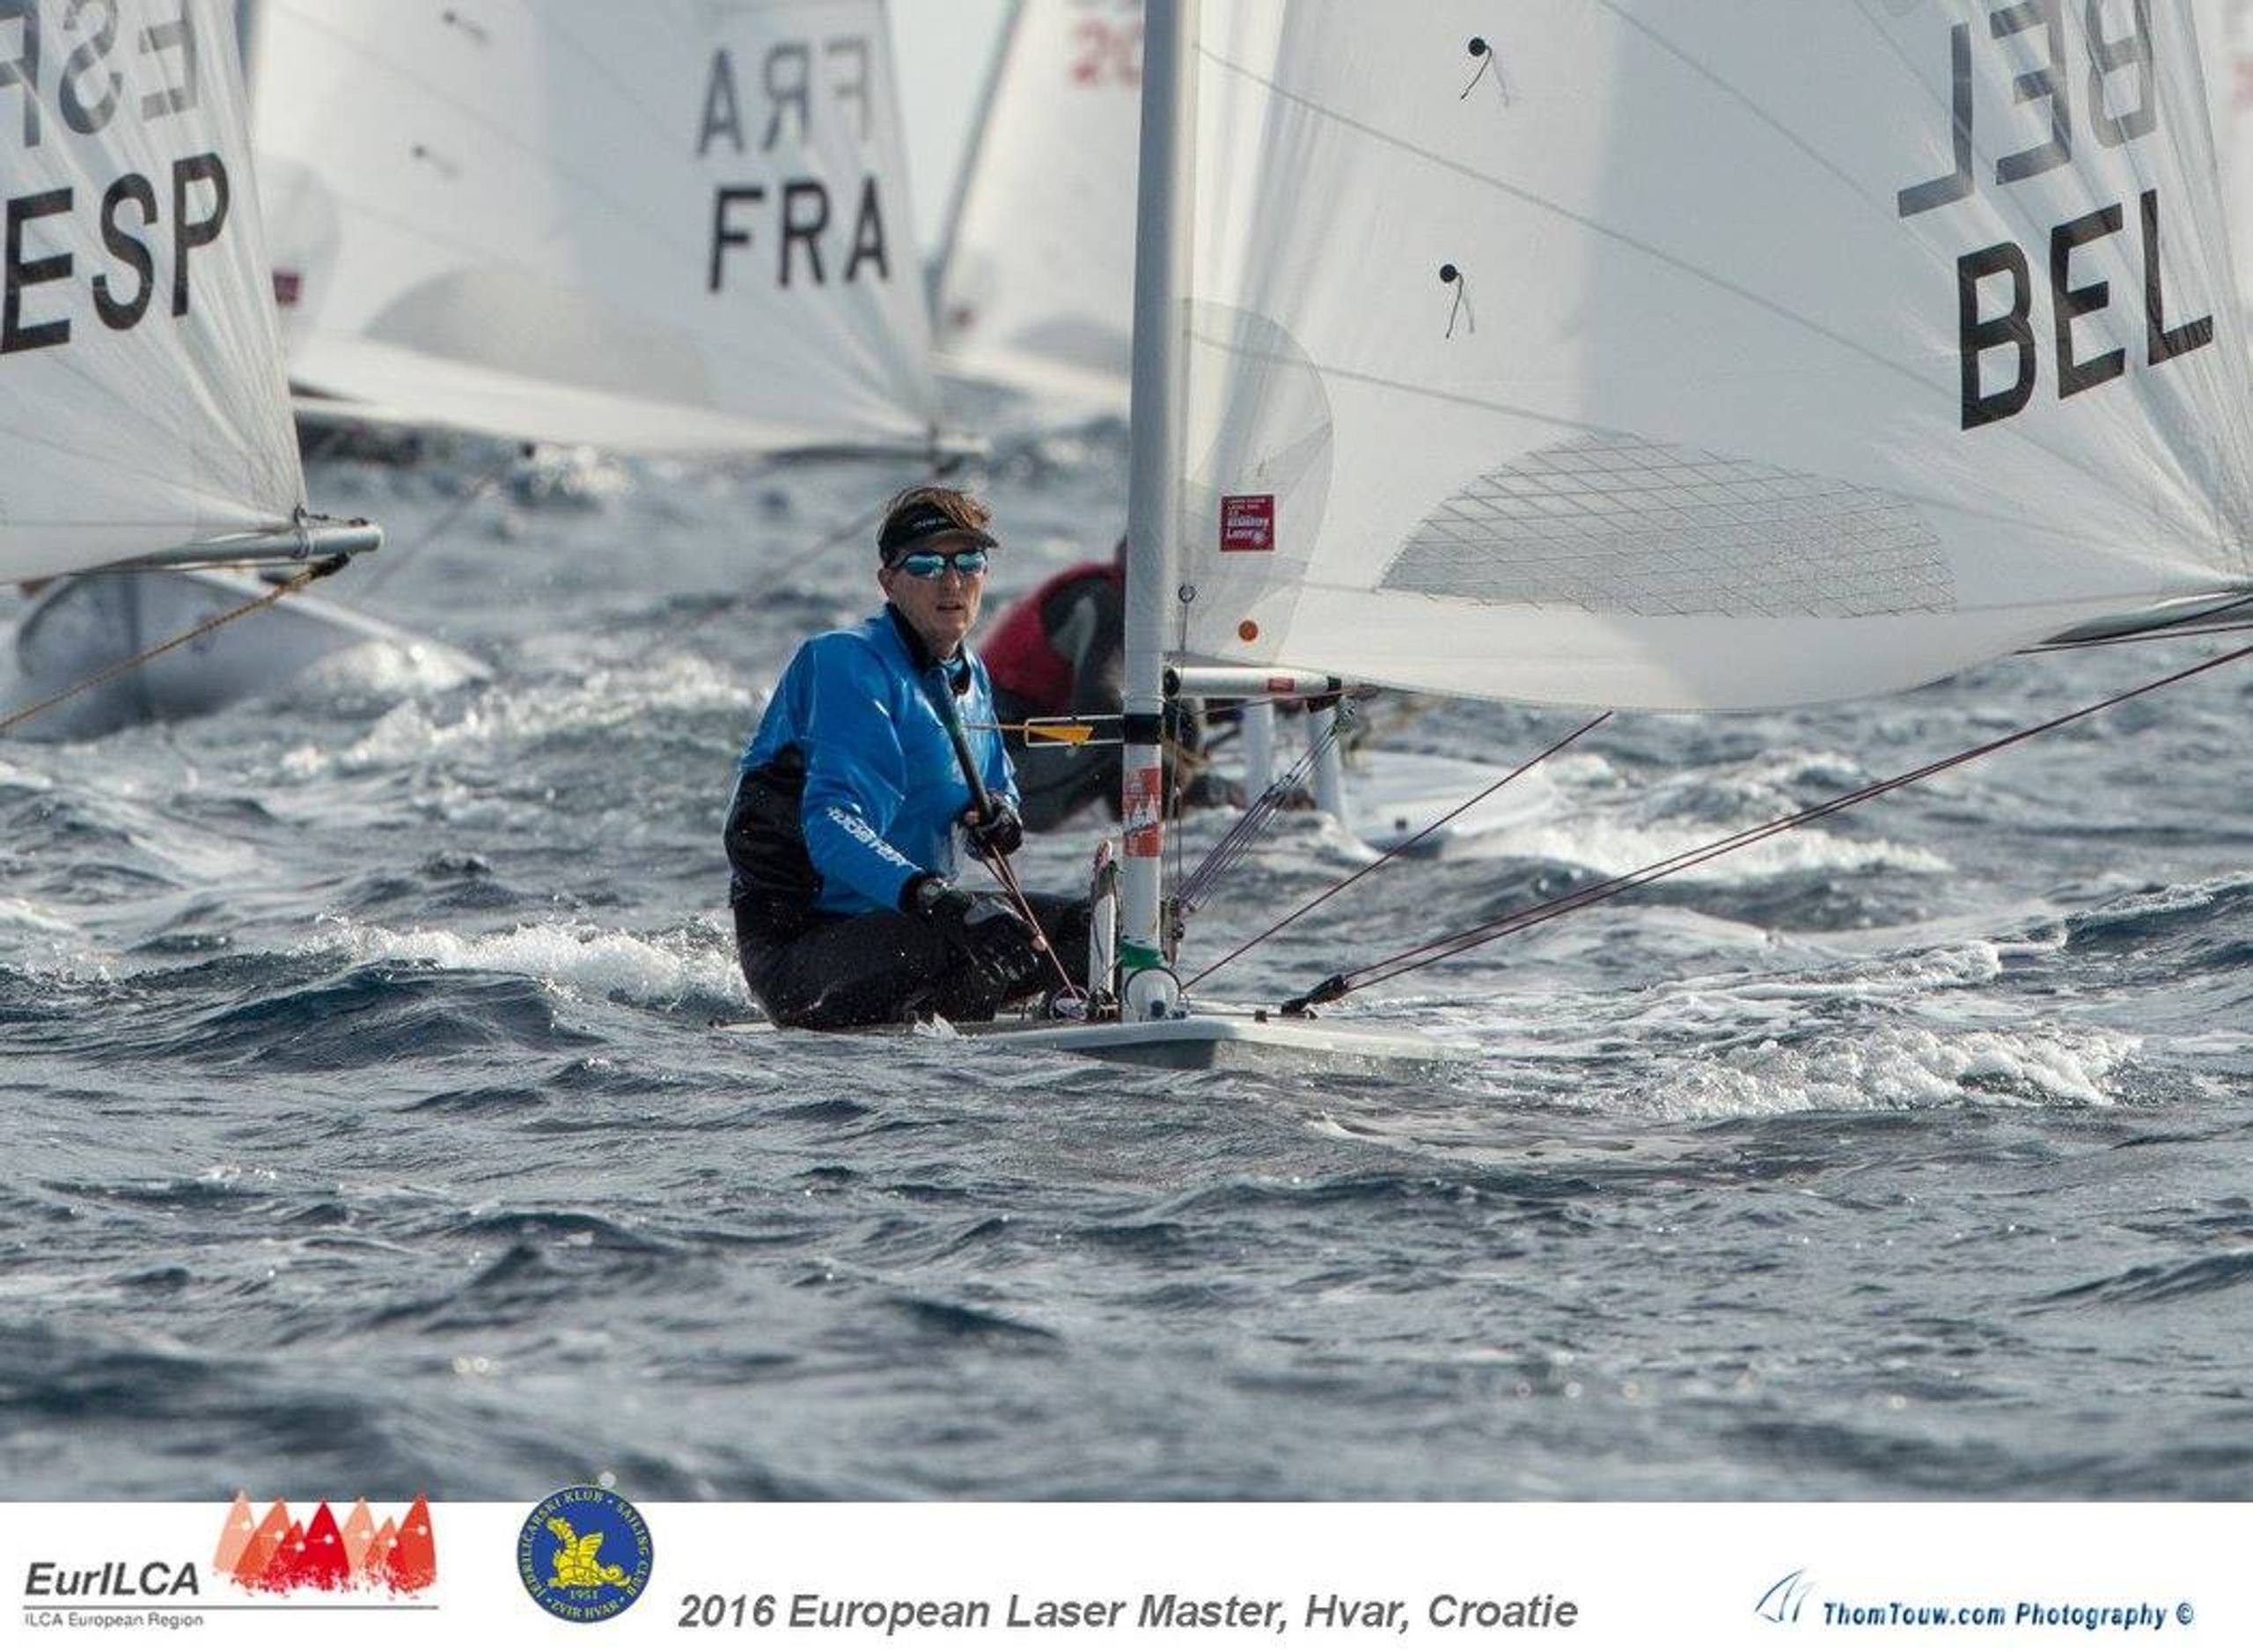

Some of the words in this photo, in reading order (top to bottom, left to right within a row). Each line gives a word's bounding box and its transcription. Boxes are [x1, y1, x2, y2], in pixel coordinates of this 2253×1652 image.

[0, 151, 230, 354] ESP
[708, 178, 890, 292] FRA
[1956, 188, 2214, 431] BEL
